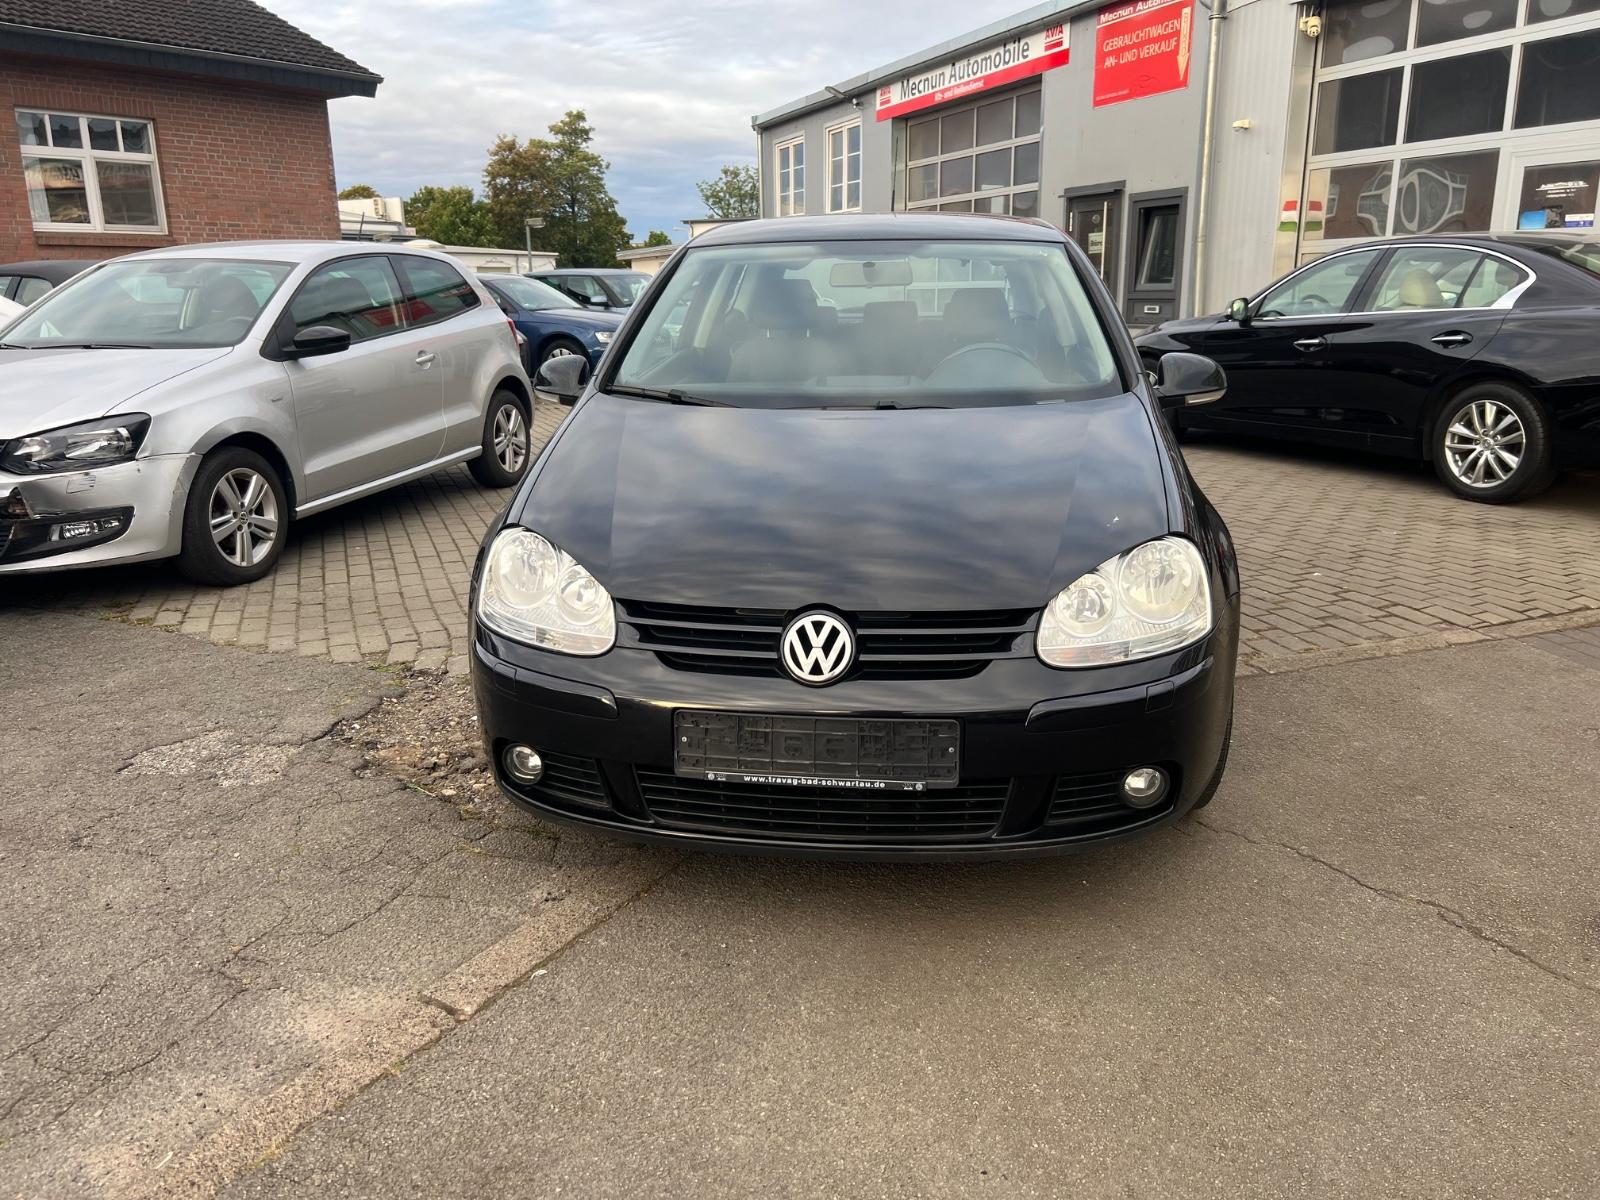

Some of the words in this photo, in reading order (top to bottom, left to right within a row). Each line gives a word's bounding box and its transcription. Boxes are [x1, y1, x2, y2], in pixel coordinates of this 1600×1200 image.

[1100, 7, 1134, 23] Mecnun
[1044, 22, 1064, 39] AVIA
[1103, 18, 1181, 51] GEBRAUCHTWAGEN
[1103, 55, 1118, 69] AN-
[1119, 49, 1138, 64] UND
[1139, 37, 1178, 59] VERKAUF
[900, 71, 945, 101] Mecnun
[948, 37, 1030, 83] Automobile
[743, 775, 886, 788] www.travag-bad-schwartau.de
